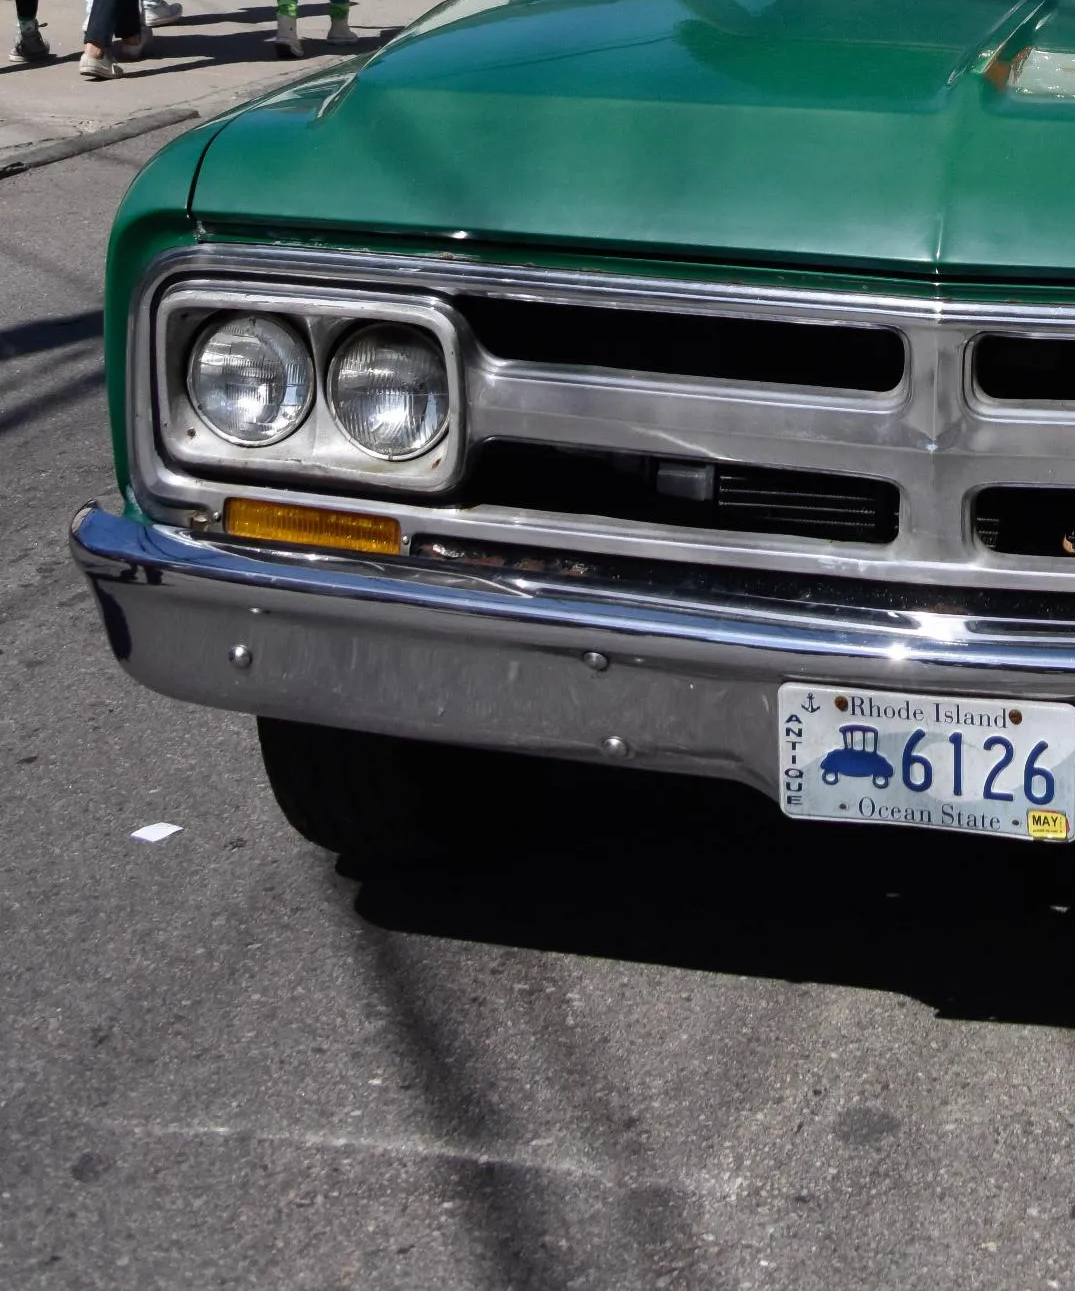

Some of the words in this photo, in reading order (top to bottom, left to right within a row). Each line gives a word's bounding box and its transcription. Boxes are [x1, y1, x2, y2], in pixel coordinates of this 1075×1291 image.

[849, 696, 925, 722] Rhode
[933, 703, 1008, 729] Island
[785, 714, 803, 806] ANTIQUE
[901, 728, 1056, 806] 6126
[858, 796, 932, 824] Ocean
[941, 802, 1001, 830] State
[1032, 814, 1058, 827] MAY
